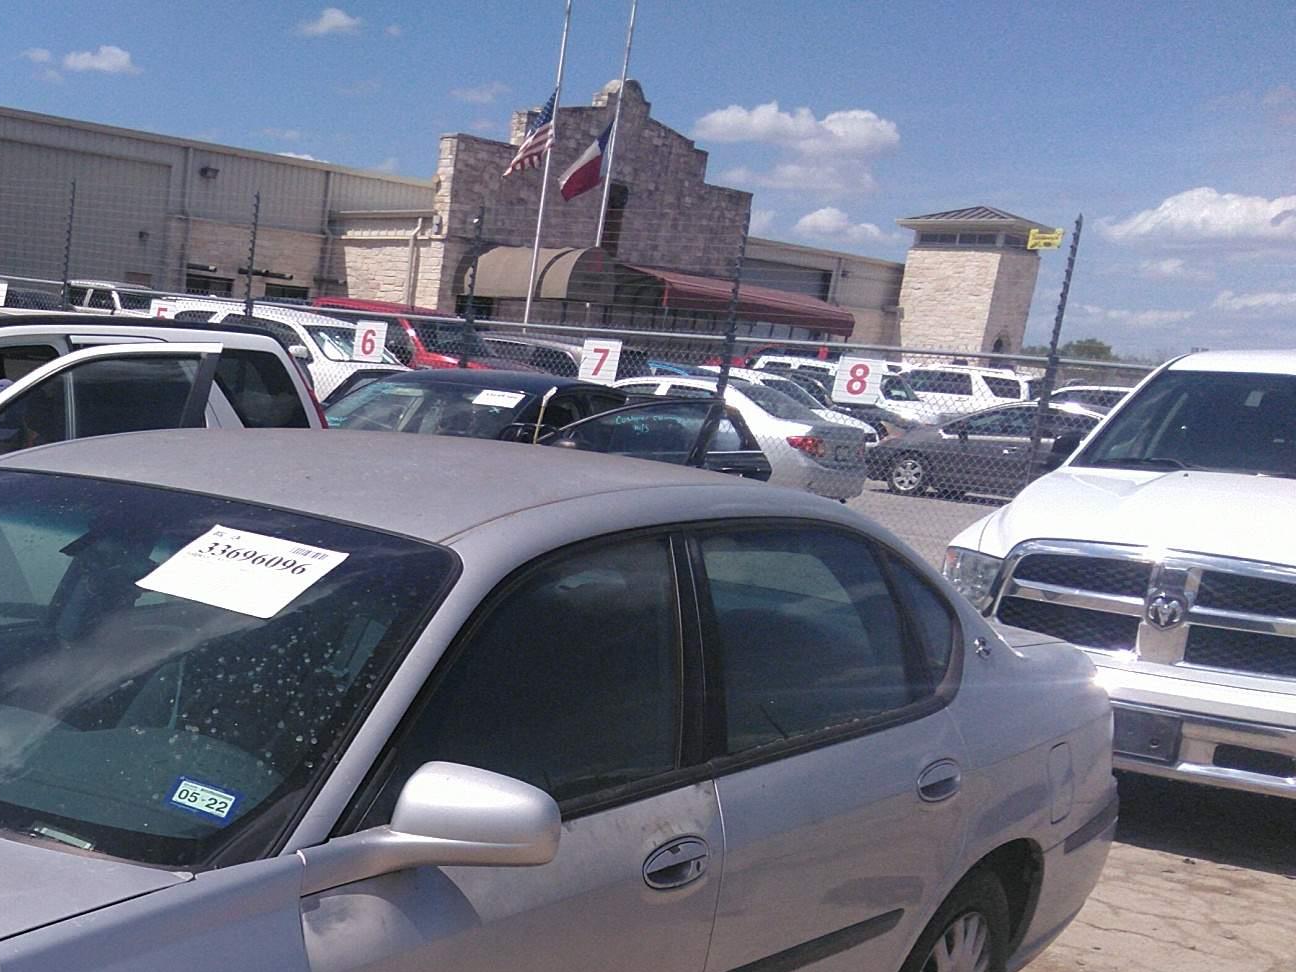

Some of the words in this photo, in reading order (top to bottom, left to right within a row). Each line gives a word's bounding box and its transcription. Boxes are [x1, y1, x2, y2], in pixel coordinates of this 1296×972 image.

[361, 329, 376, 355] 6
[591, 348, 610, 376] 7
[846, 363, 870, 395] 8
[197, 541, 312, 575] 33696096
[177, 788, 228, 813] 05-22
